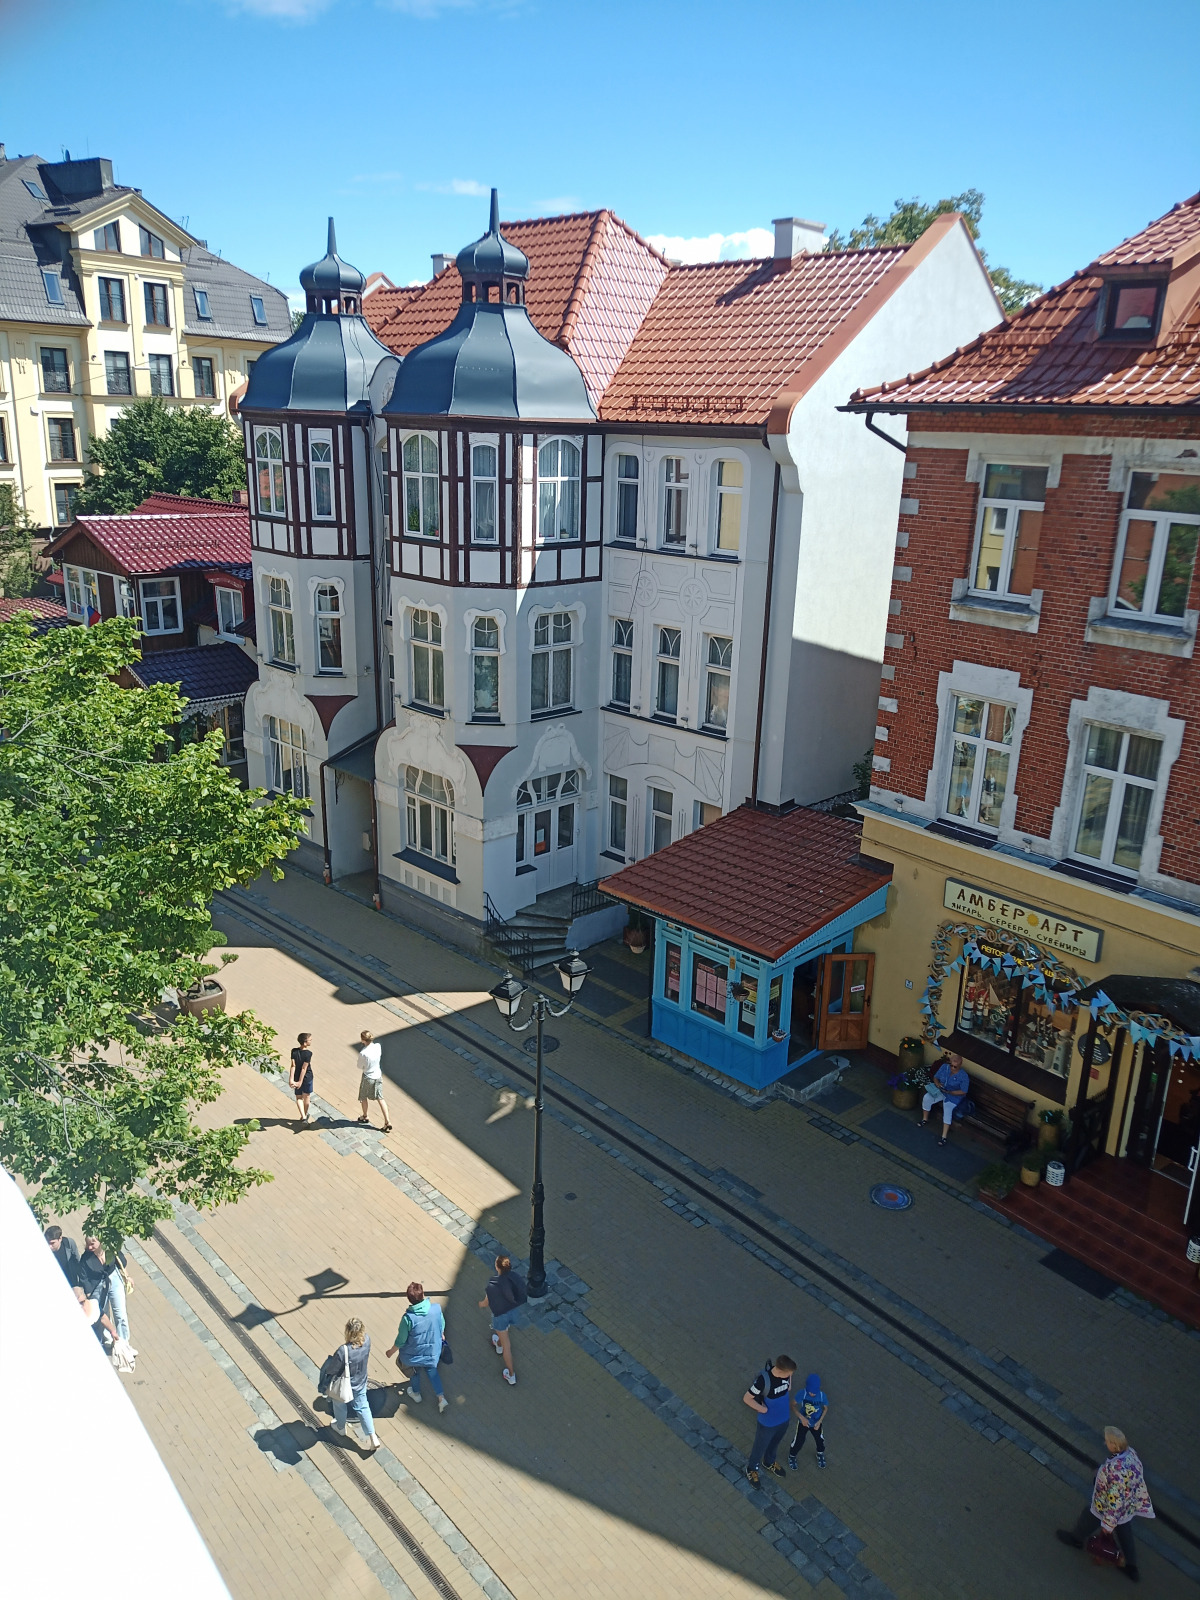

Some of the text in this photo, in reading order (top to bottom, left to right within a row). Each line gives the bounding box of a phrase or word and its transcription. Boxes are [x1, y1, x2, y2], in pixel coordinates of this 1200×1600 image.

[957, 888, 1083, 942] АМБЕР АРТ
[1037, 933, 1086, 956] СУВЕНИРЫ
